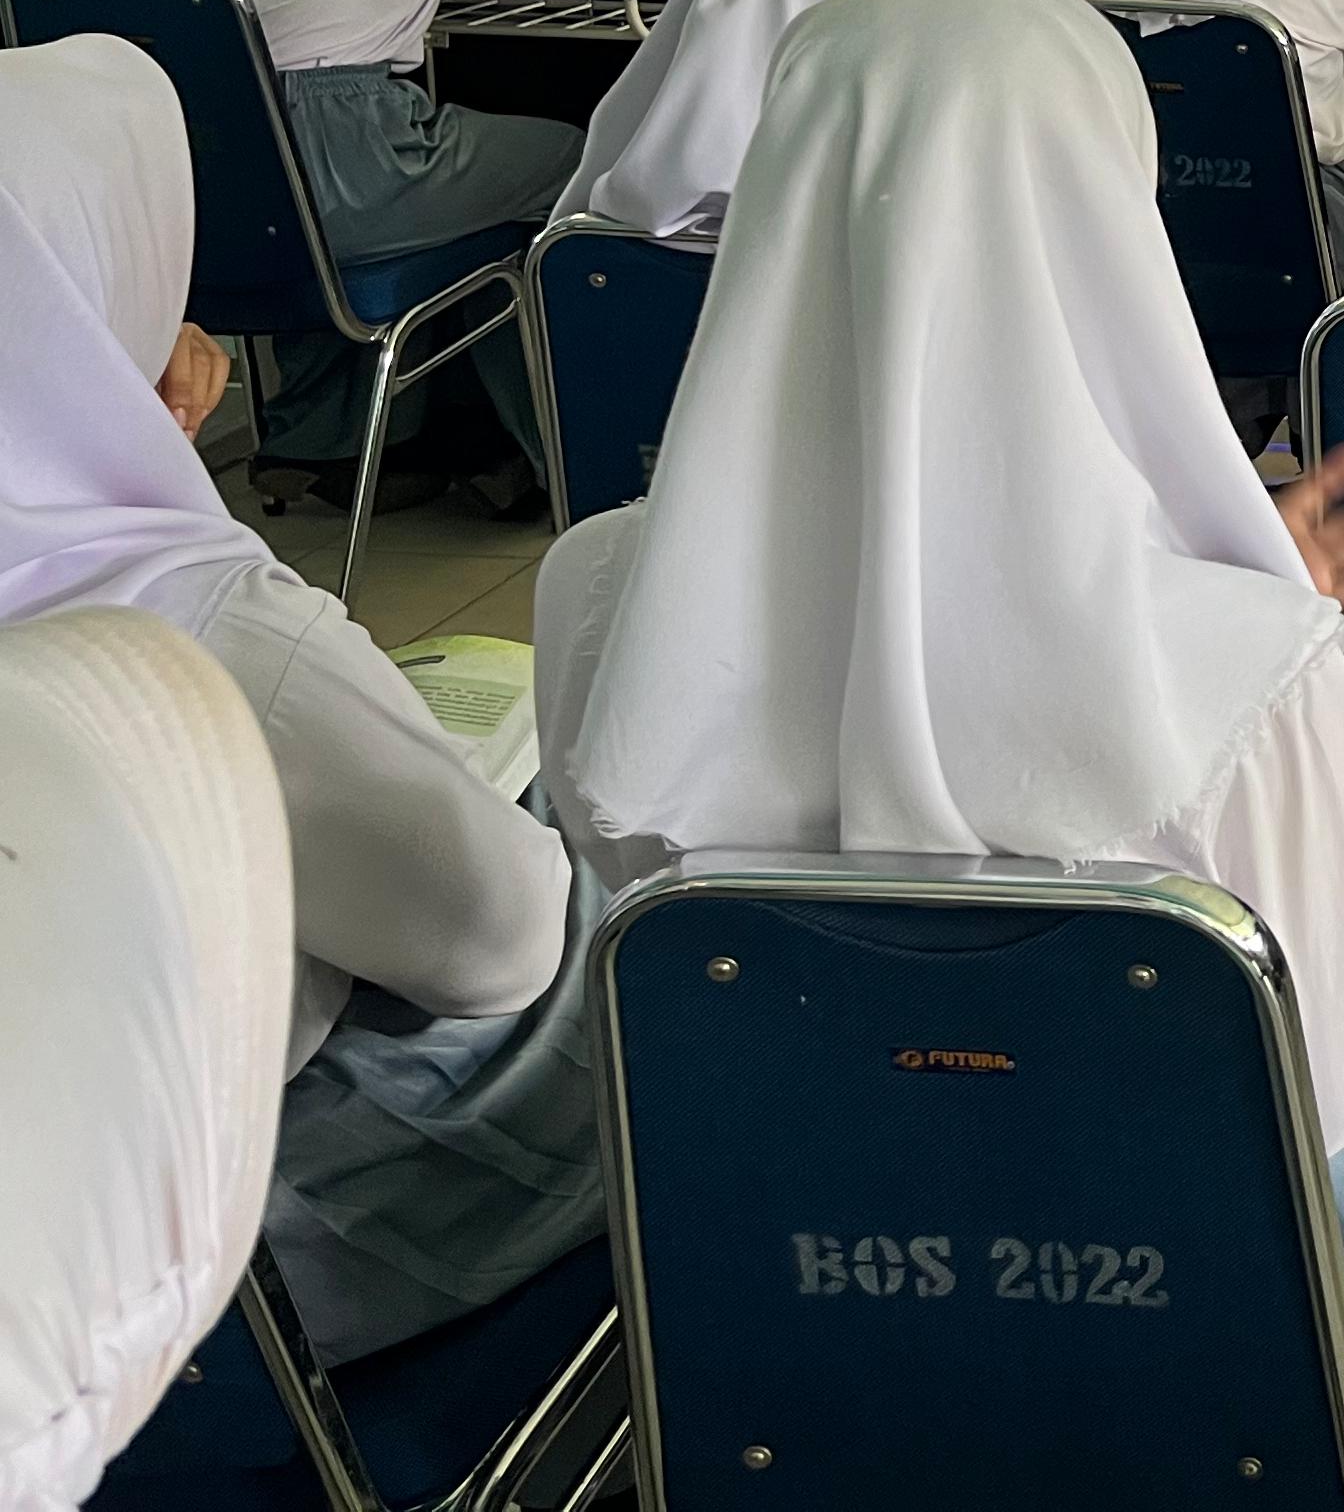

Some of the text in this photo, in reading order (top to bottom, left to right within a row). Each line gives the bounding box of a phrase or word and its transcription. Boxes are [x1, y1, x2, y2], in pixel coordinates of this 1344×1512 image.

[1174, 154, 1252, 189] 2022
[928, 1050, 1009, 1070] FUTURA
[791, 1233, 1170, 1308] BOS 2022
